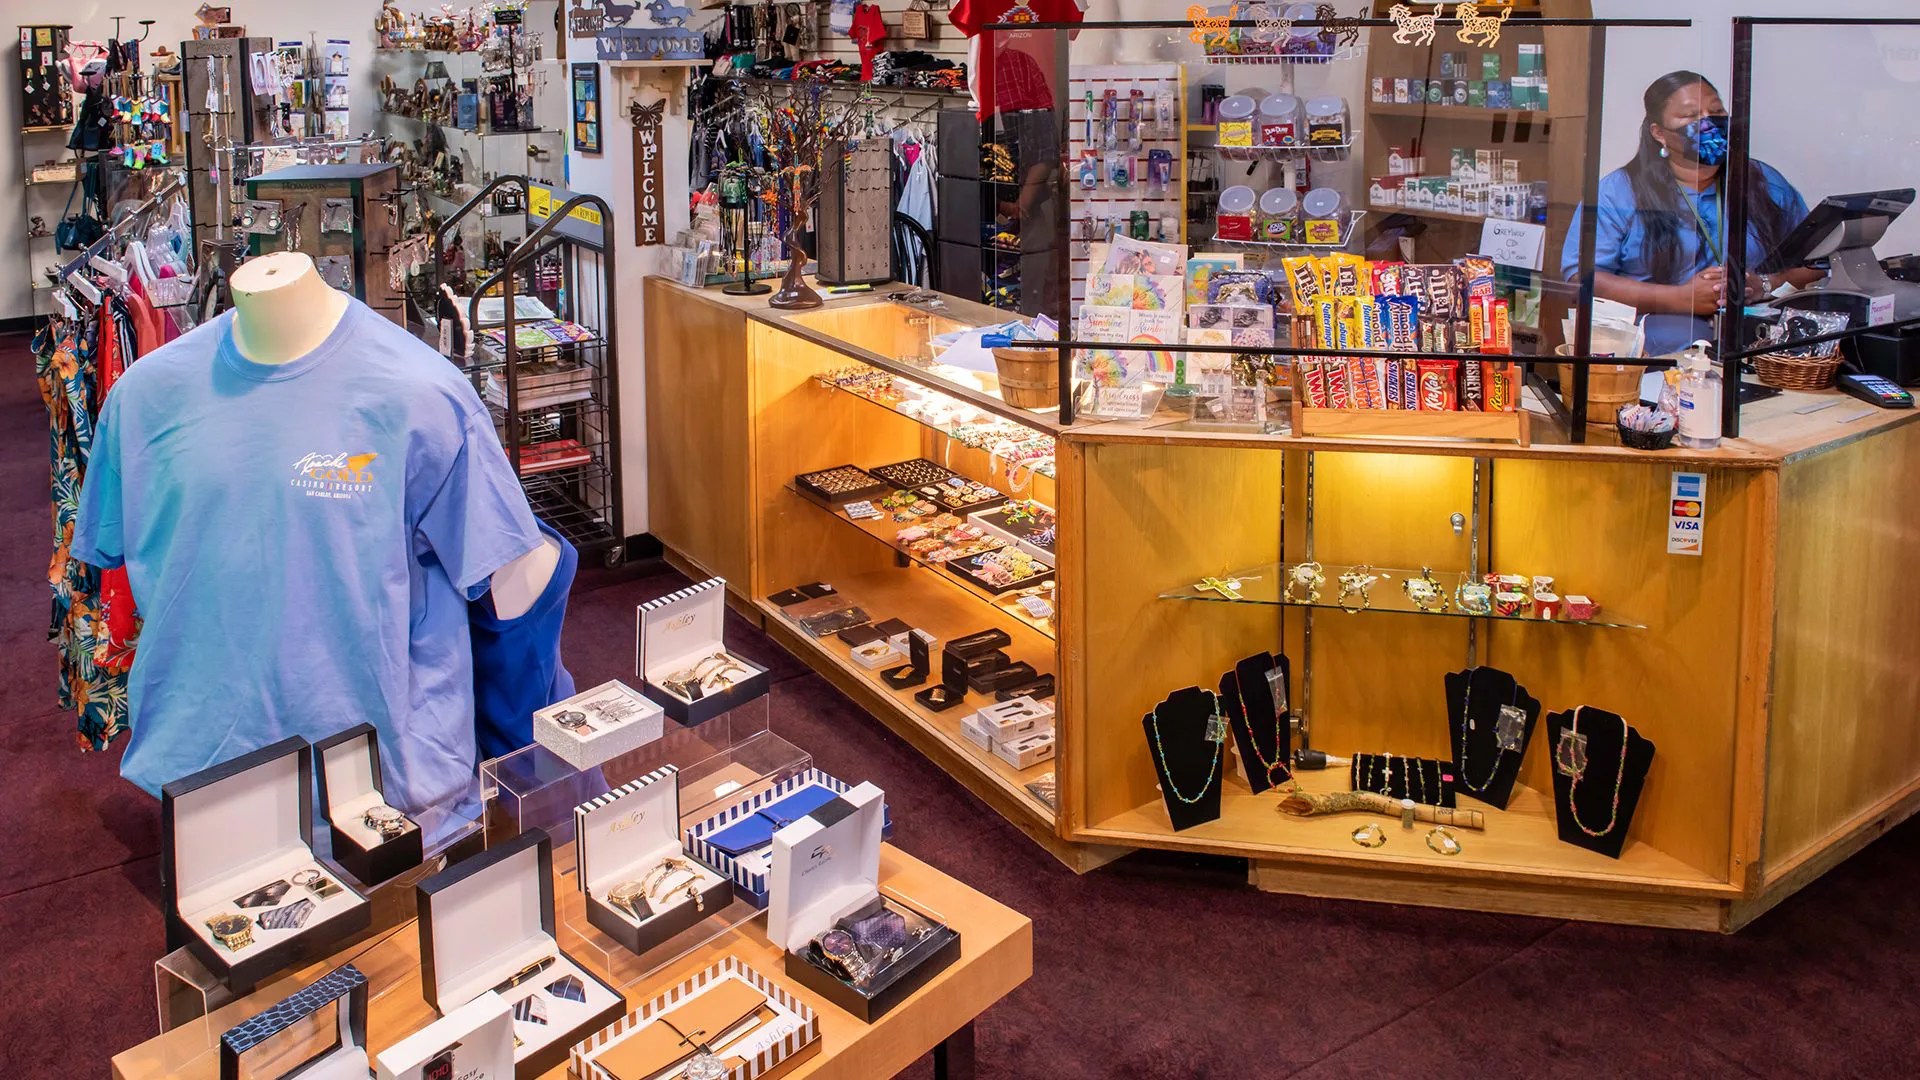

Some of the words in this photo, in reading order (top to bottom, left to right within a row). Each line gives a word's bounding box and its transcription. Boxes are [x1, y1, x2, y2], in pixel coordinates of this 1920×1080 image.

[600, 37, 701, 53] WELCOME
[638, 129, 658, 242] WELCOME
[1363, 305, 1372, 347] Butterfinge
[1391, 303, 1400, 342] Almond
[1401, 303, 1411, 343] Almond
[1389, 363, 1398, 401] SNICKERS
[1406, 373, 1416, 410] SNICKERS
[1466, 360, 1481, 399] ERSHEY'S
[292, 452, 347, 475] Apache
[310, 468, 373, 483] GOLD
[291, 479, 325, 489] CASINO
[335, 484, 372, 492] RESORT
[1675, 521, 1699, 530] VISA
[755, 1023, 794, 1050] Ashley
